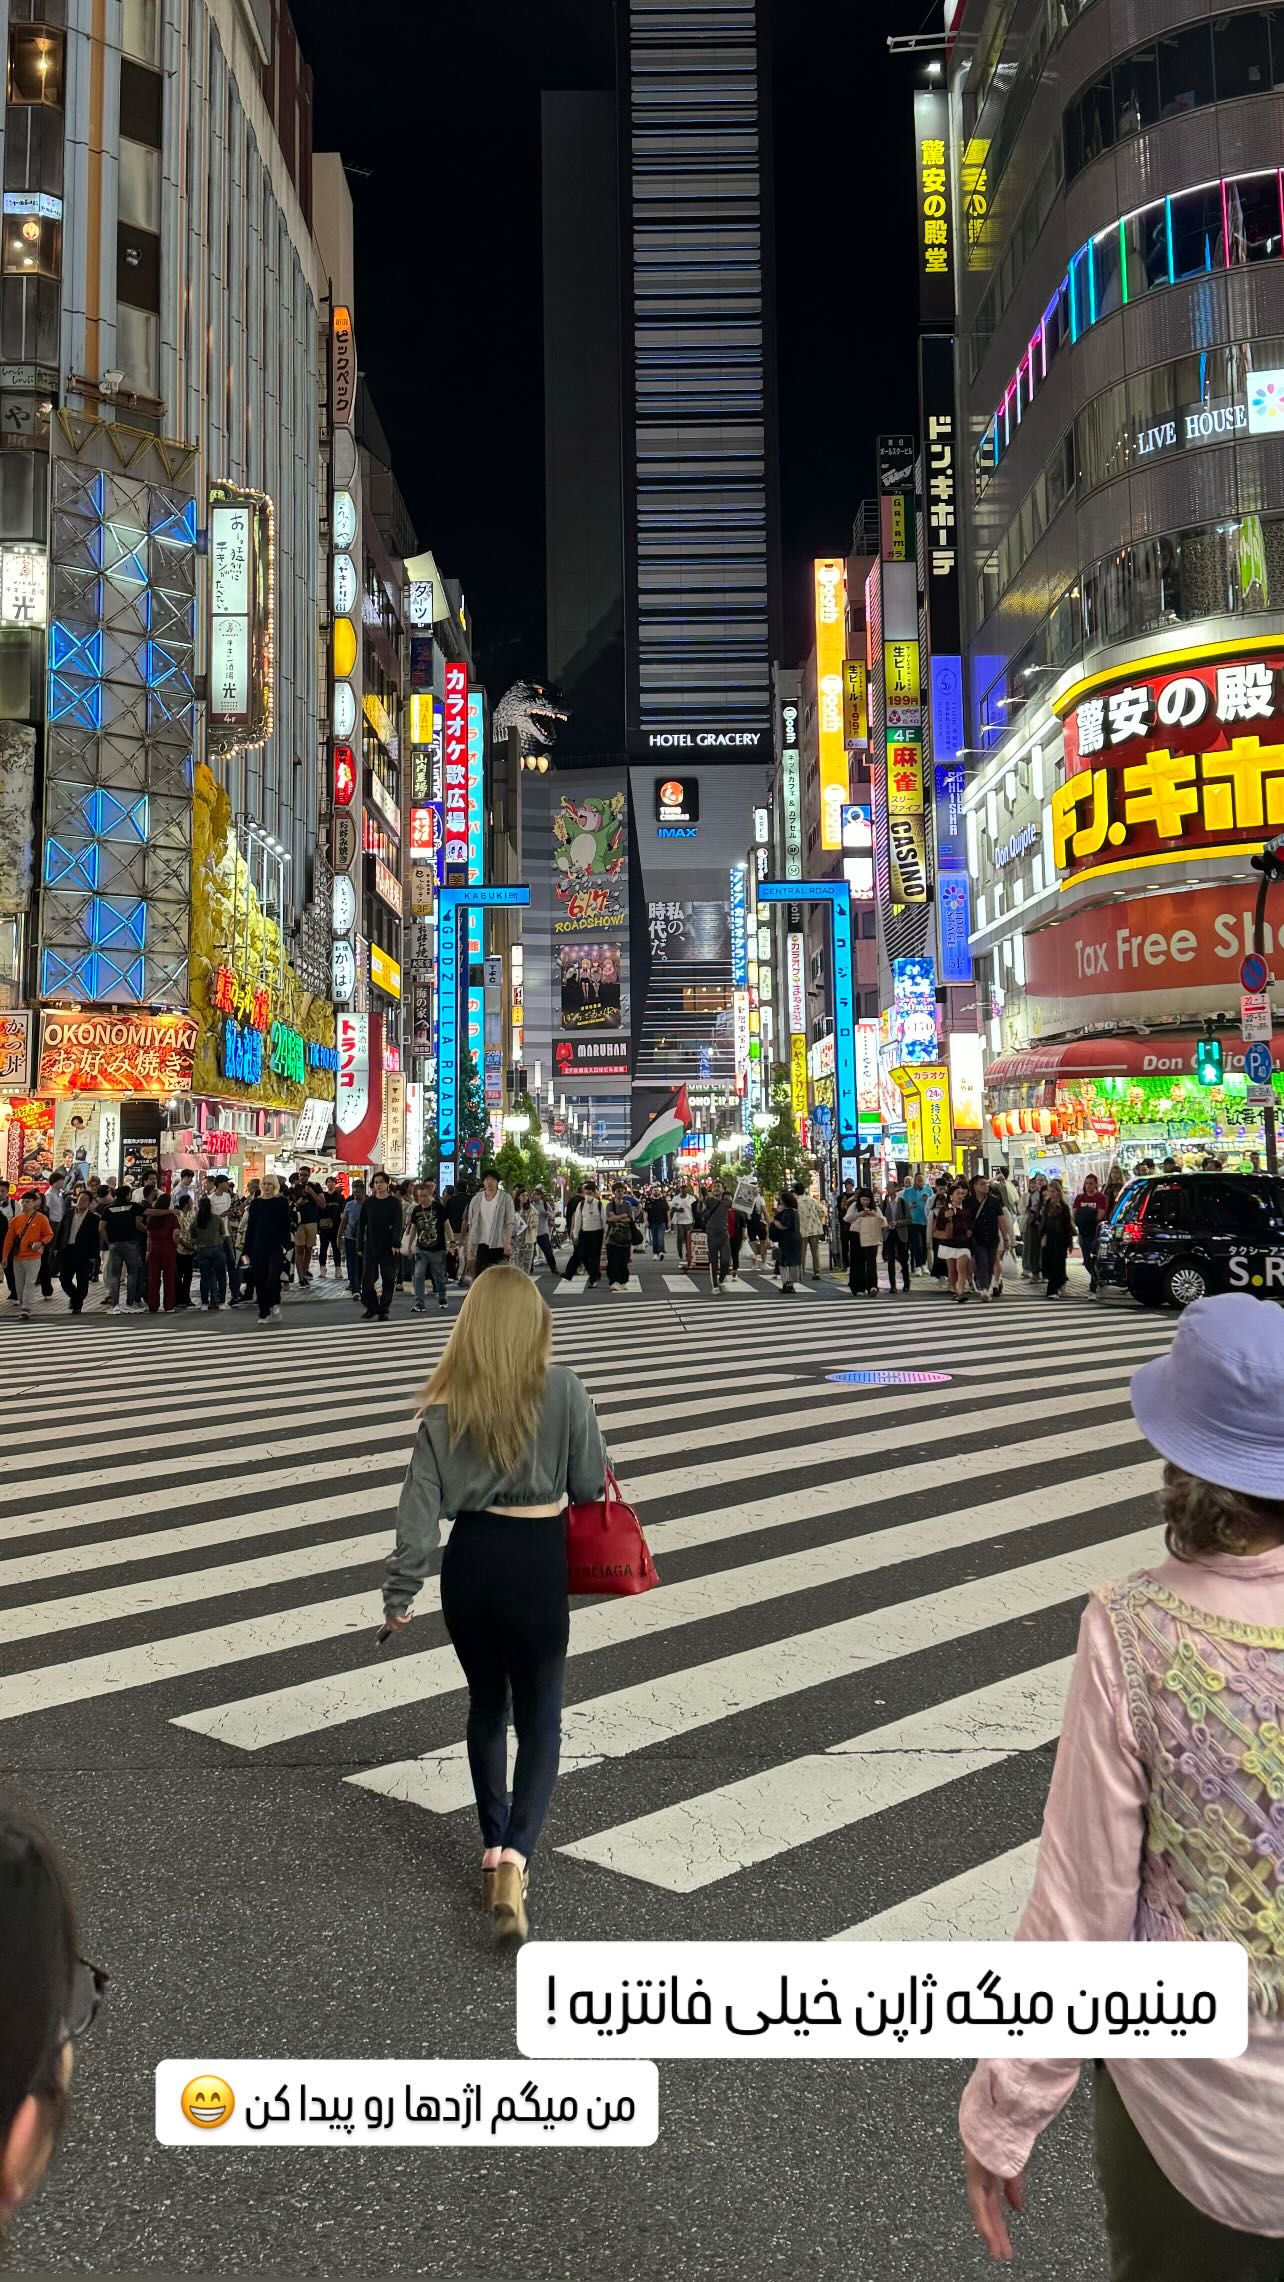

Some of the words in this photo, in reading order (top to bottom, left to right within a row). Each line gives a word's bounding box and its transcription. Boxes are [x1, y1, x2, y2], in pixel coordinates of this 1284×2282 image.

[921, 139, 948, 273] 驚安の殿堂
[1137, 421, 1177, 455] LIVE
[1185, 404, 1247, 439] HOUSE
[848, 665, 859, 702] 生ビール
[893, 646, 906, 692] 生ビール
[222, 682, 237, 699] 光
[888, 695, 919, 706] 199円
[223, 713, 237, 724] 4F
[1076, 663, 1275, 757] 驚安の殿
[445, 668, 466, 833] カラオケ歌広場
[649, 733, 695, 747] HOTEL
[696, 733, 761, 746] GRACERY
[893, 730, 915, 742] 4F
[788, 755, 796, 796] ネットカフェ
[893, 747, 918, 792] 麻雀
[339, 820, 349, 864] お好み焼き
[658, 828, 698, 838] IMAX
[789, 812, 797, 839] カプセル
[891, 820, 925, 898] CASINO
[994, 845, 1009, 870] Don
[1009, 823, 1037, 861] Quijote
[568, 889, 609, 918] 6/7
[763, 887, 807, 895] CENTRAL
[809, 886, 835, 895] ROAD
[416, 905, 428, 913] 3F
[554, 912, 625, 933] ROADSHOW!
[666, 901, 686, 941] 私の、
[791, 901, 800, 924] ooth
[648, 902, 668, 961] 時代だ。
[947, 912, 956, 947] STAGE
[956, 913, 964, 940] IDOL
[1075, 940, 1110, 979] Tax
[1116, 928, 1198, 970] Free
[336, 990, 347, 998] B1
[441, 926, 454, 1046] GODZILLA
[416, 988, 428, 1019] 海の家
[836, 937, 853, 1099] ゴジラロード
[0, 1019, 26, 1078] かつ丼
[45, 1023, 197, 1050] OKONOMIYAKI
[340, 1019, 356, 1087] トラノコ
[577, 1043, 627, 1058] MARUHAN
[52, 1049, 182, 1079] お好み焼き
[913, 1071, 946, 1080] カラオケ
[1143, 1055, 1183, 1071] Don
[1250, 1053, 1261, 1078] P
[441, 1060, 454, 1117] ROAD
[930, 1104, 942, 1155] 持込OK!
